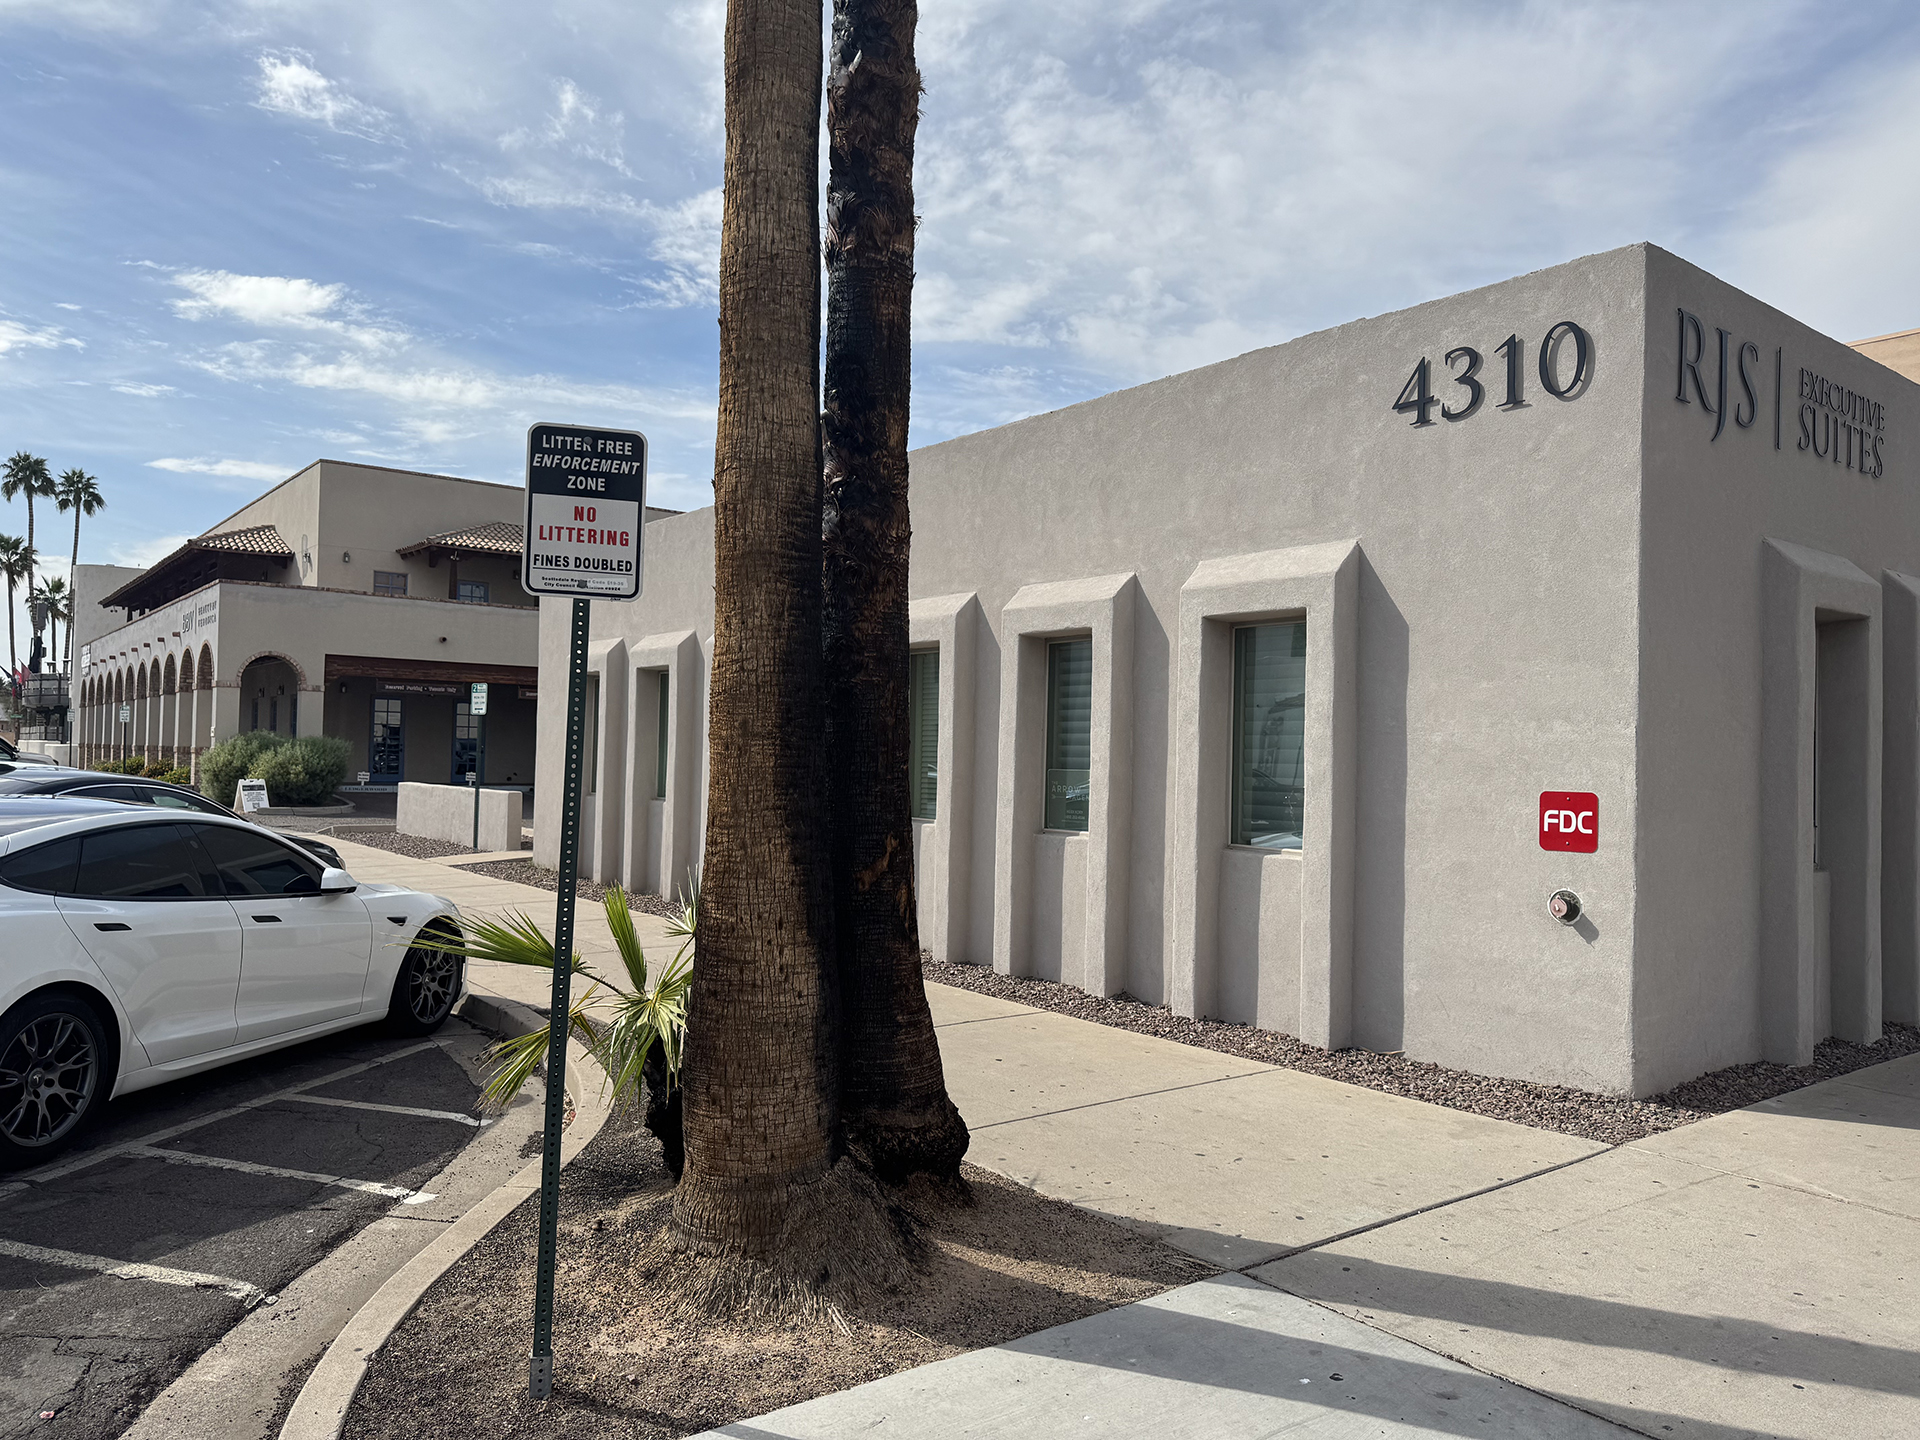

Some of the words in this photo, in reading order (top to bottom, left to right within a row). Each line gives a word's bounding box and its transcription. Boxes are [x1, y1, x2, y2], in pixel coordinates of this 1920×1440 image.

[1392, 321, 1589, 426] 4310
[1675, 308, 1759, 441] RJS
[1799, 367, 1885, 432] EXECUTIVE
[597, 440, 633, 455] FREE
[1798, 403, 1885, 478] SUITES
[532, 453, 640, 475] ENFORCEMENT
[567, 475, 606, 491] ZONE
[574, 506, 597, 522] NO
[539, 525, 630, 547] LITTERING
[533, 554, 570, 568] FINES
[574, 557, 633, 572] DOUBLED
[1051, 785, 1081, 793] ARROW
[1543, 810, 1593, 834] FDC
